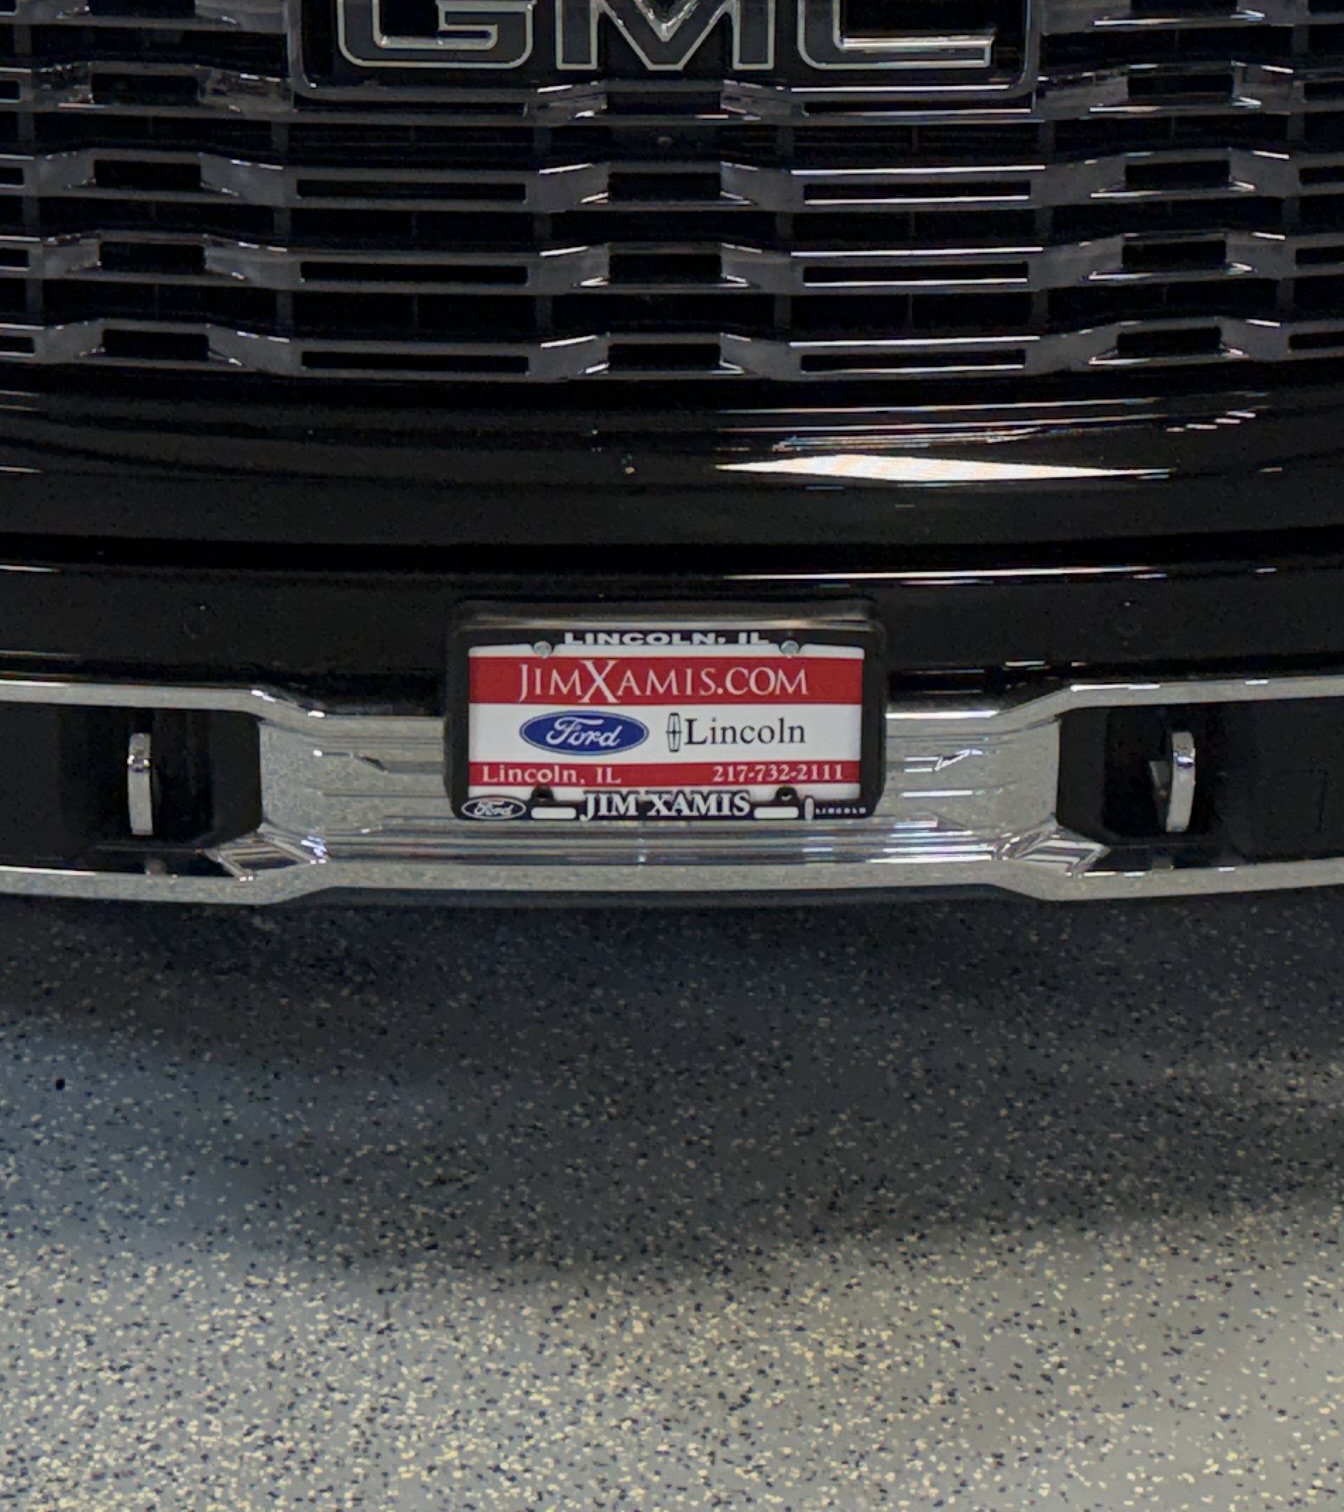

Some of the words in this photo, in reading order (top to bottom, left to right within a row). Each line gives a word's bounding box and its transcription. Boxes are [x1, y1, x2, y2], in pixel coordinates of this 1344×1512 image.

[738, 632, 770, 645] IL
[546, 717, 623, 747] Ford
[684, 717, 806, 745] Lincoln
[596, 767, 622, 784] IL
[713, 764, 843, 783] 217-732-2111
[473, 800, 515, 817] Ford
[579, 791, 638, 821] JIM
[646, 791, 751, 817] XAMIS
